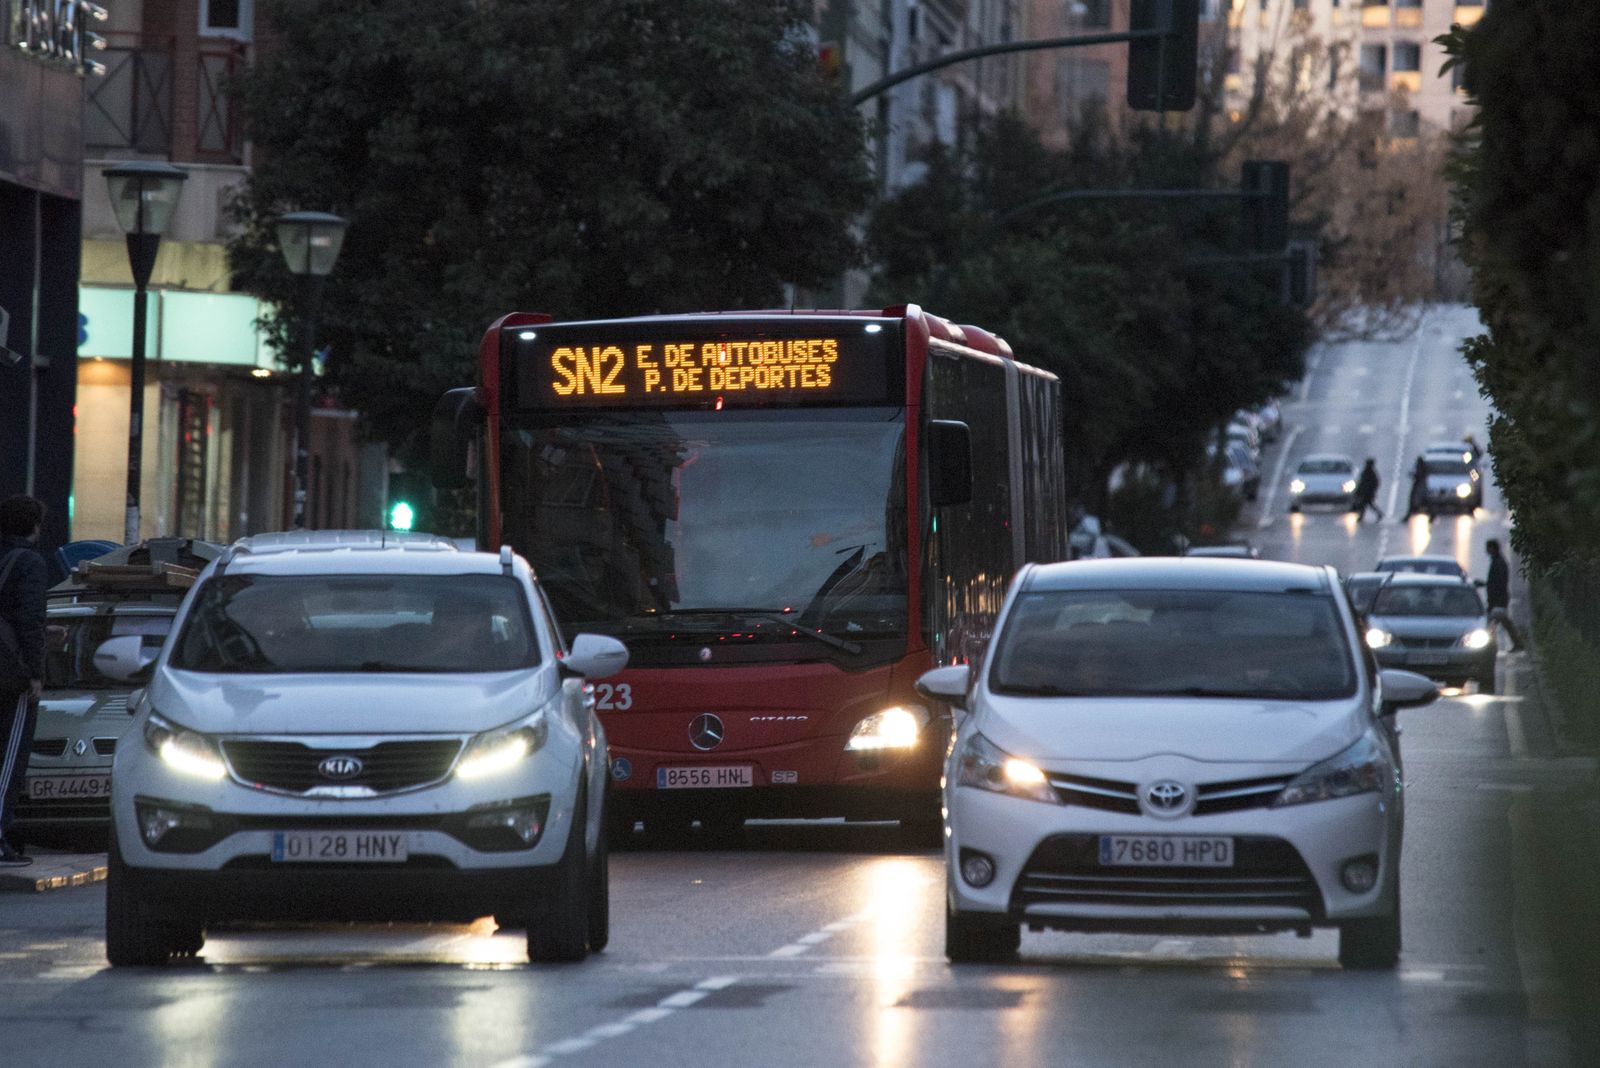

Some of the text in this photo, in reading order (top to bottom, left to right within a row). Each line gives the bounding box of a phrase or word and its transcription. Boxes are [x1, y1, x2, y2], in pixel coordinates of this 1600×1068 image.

[637, 339, 838, 368] E. DE AUTOBUSES
[551, 346, 626, 395] SN2
[645, 364, 832, 392] P. DE DEPORTES
[325, 760, 355, 773] KIA
[668, 768, 749, 786] 8556 HNL
[773, 771, 796, 782] SP
[288, 835, 400, 857] 0128 HNY
[1115, 839, 1228, 862] 7680 HPD
